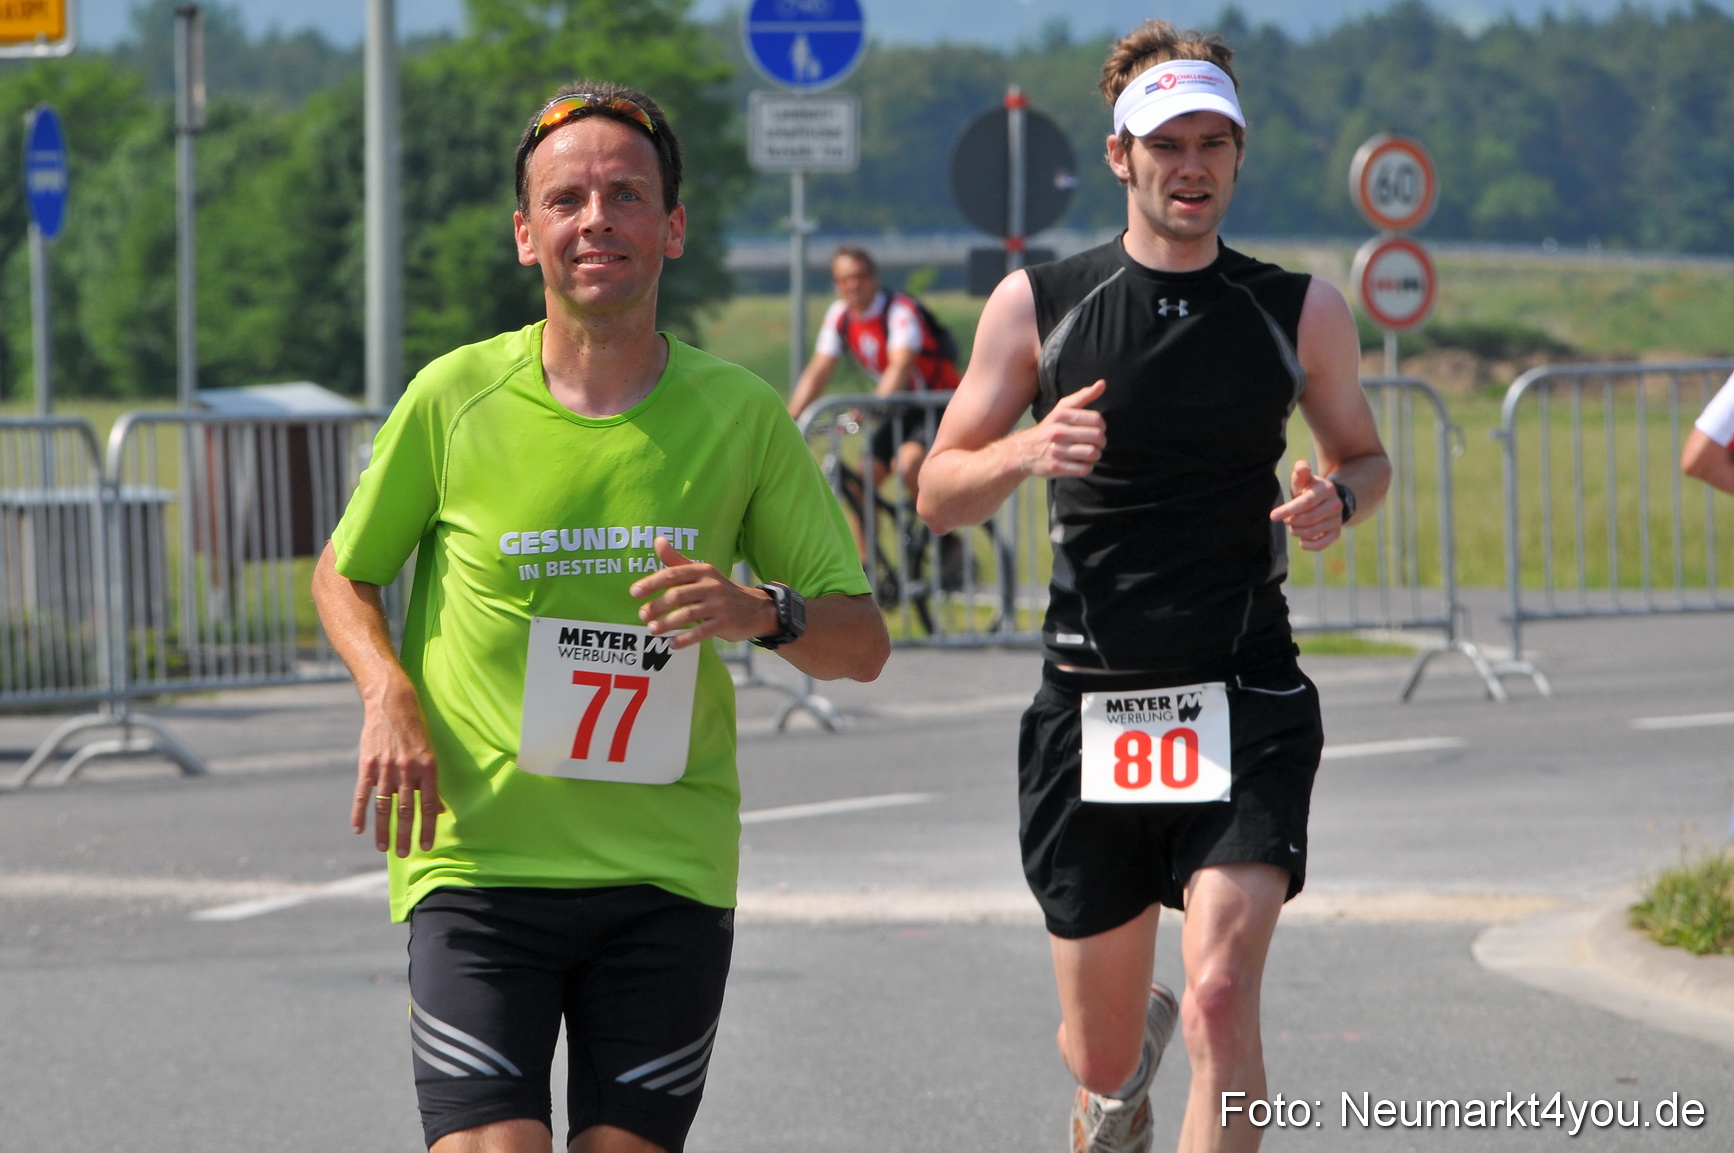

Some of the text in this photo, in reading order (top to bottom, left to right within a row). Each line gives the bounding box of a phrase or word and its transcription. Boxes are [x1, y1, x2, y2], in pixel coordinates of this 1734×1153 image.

[1374, 161, 1415, 206] 60
[500, 525, 699, 555] GESUNDHEIT
[519, 564, 540, 581] IN
[546, 558, 622, 577] BESTEN
[558, 627, 638, 651] MEYER
[558, 646, 638, 666] WERBUNG
[570, 670, 650, 762] 77
[1106, 695, 1172, 713] MEYER
[1106, 711, 1174, 724] WERBUNG
[1113, 727, 1199, 789] 80
